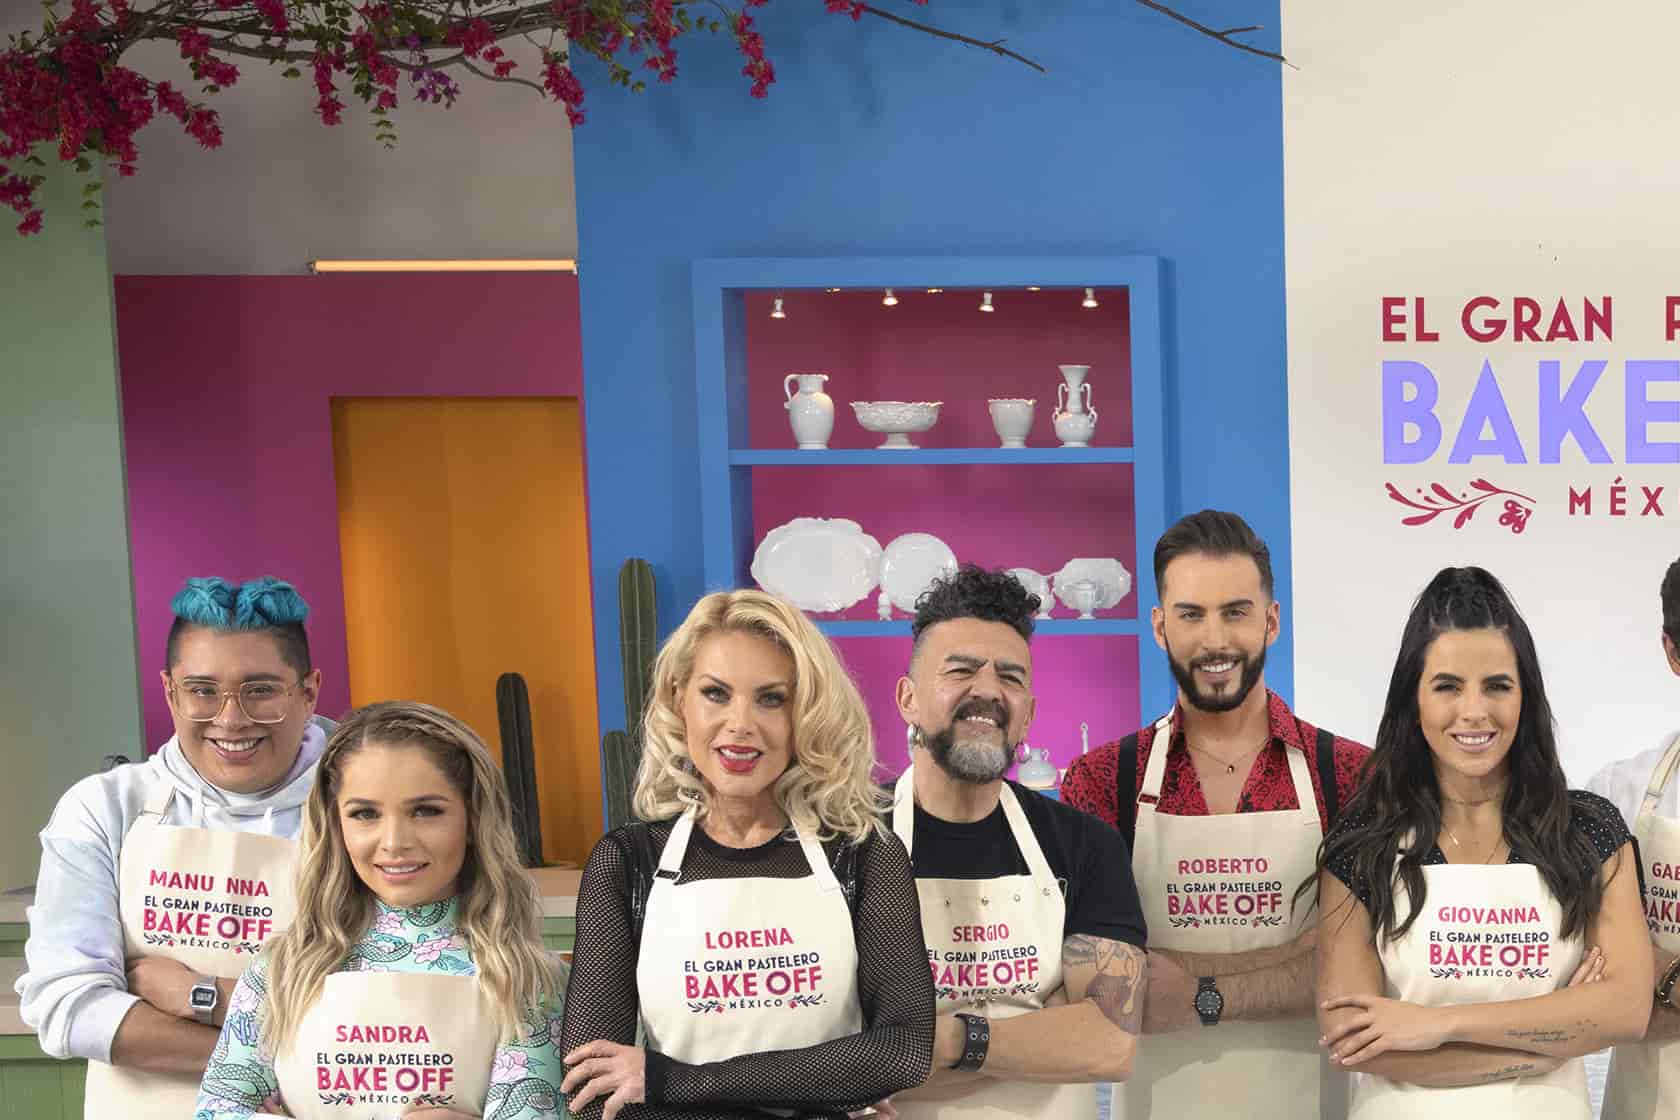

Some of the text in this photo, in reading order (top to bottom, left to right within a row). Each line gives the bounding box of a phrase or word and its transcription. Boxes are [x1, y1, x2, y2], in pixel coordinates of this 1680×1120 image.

[1382, 296, 1439, 342] EL
[1461, 296, 1612, 342] GRAN
[1382, 357, 1680, 465] BAKE
[1178, 858, 1268, 875] ROBERTO
[150, 870, 269, 897] MANU NNA
[1167, 881, 1282, 893] EL GRAN PASTELERO
[1651, 886, 1677, 899] GRAN
[145, 896, 272, 917] EL GRAN PASTELERO
[1168, 893, 1282, 915] BAKE OFF
[144, 909, 272, 940] BAKE OFF
[1204, 917, 1247, 925] MÉXICO
[1438, 907, 1540, 925] GIOVANNA
[180, 935, 229, 949] MÉXICO
[705, 928, 794, 949] LORENA
[952, 923, 1009, 943] SERGIO
[1430, 931, 1549, 943] EL GRAN PASTELERO
[684, 952, 819, 972] EL GRAN PASTELERO
[928, 945, 1037, 962] EL GRAN PASTELERO
[1430, 944, 1549, 966] BAKE OFF
[993, 958, 1039, 984] OFF
[1467, 968, 1512, 977] MÉXICO
[686, 966, 822, 999] BAKE OFF
[730, 998, 782, 1008] MÉXICO
[336, 1025, 430, 1043] SANDRA
[317, 1053, 453, 1065] EL GRAN PASTELERO
[317, 1067, 454, 1091] BAKE OFF
[360, 1093, 409, 1104] MÉXICO
